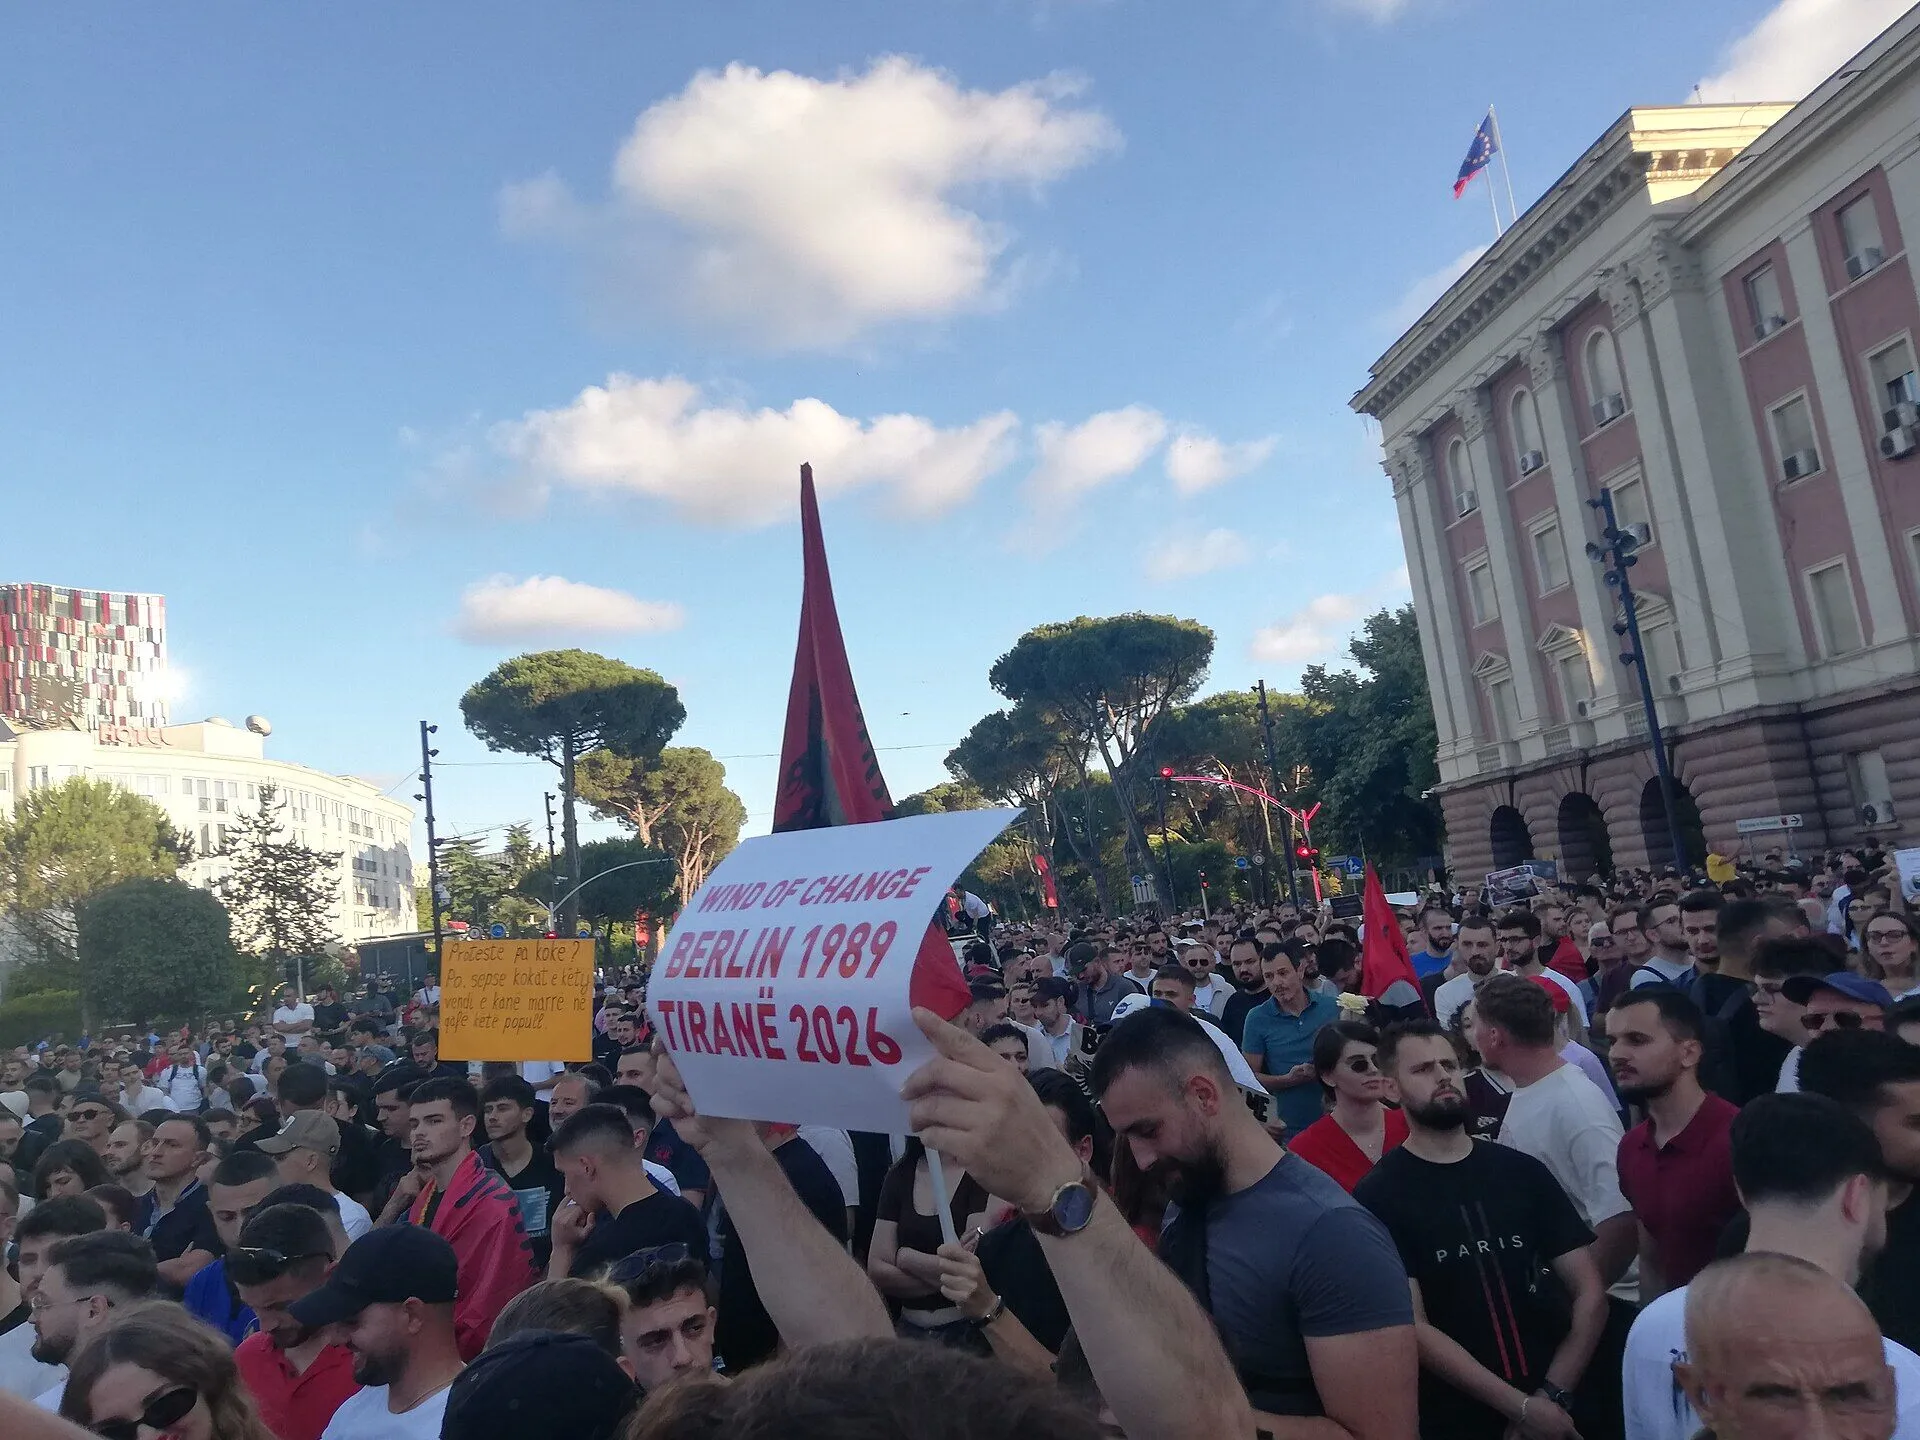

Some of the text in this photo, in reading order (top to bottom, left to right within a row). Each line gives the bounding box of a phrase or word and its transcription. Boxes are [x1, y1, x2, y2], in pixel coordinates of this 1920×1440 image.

[698, 866, 932, 913] WIND OF CHANGE
[513, 946, 529, 964] pa
[665, 920, 898, 979] BERLIN 1989
[551, 974, 558, 986] e
[480, 996, 488, 1010] e
[658, 986, 902, 1067] TIRANË 2026
[1436, 1235, 1523, 1262] PARIS
